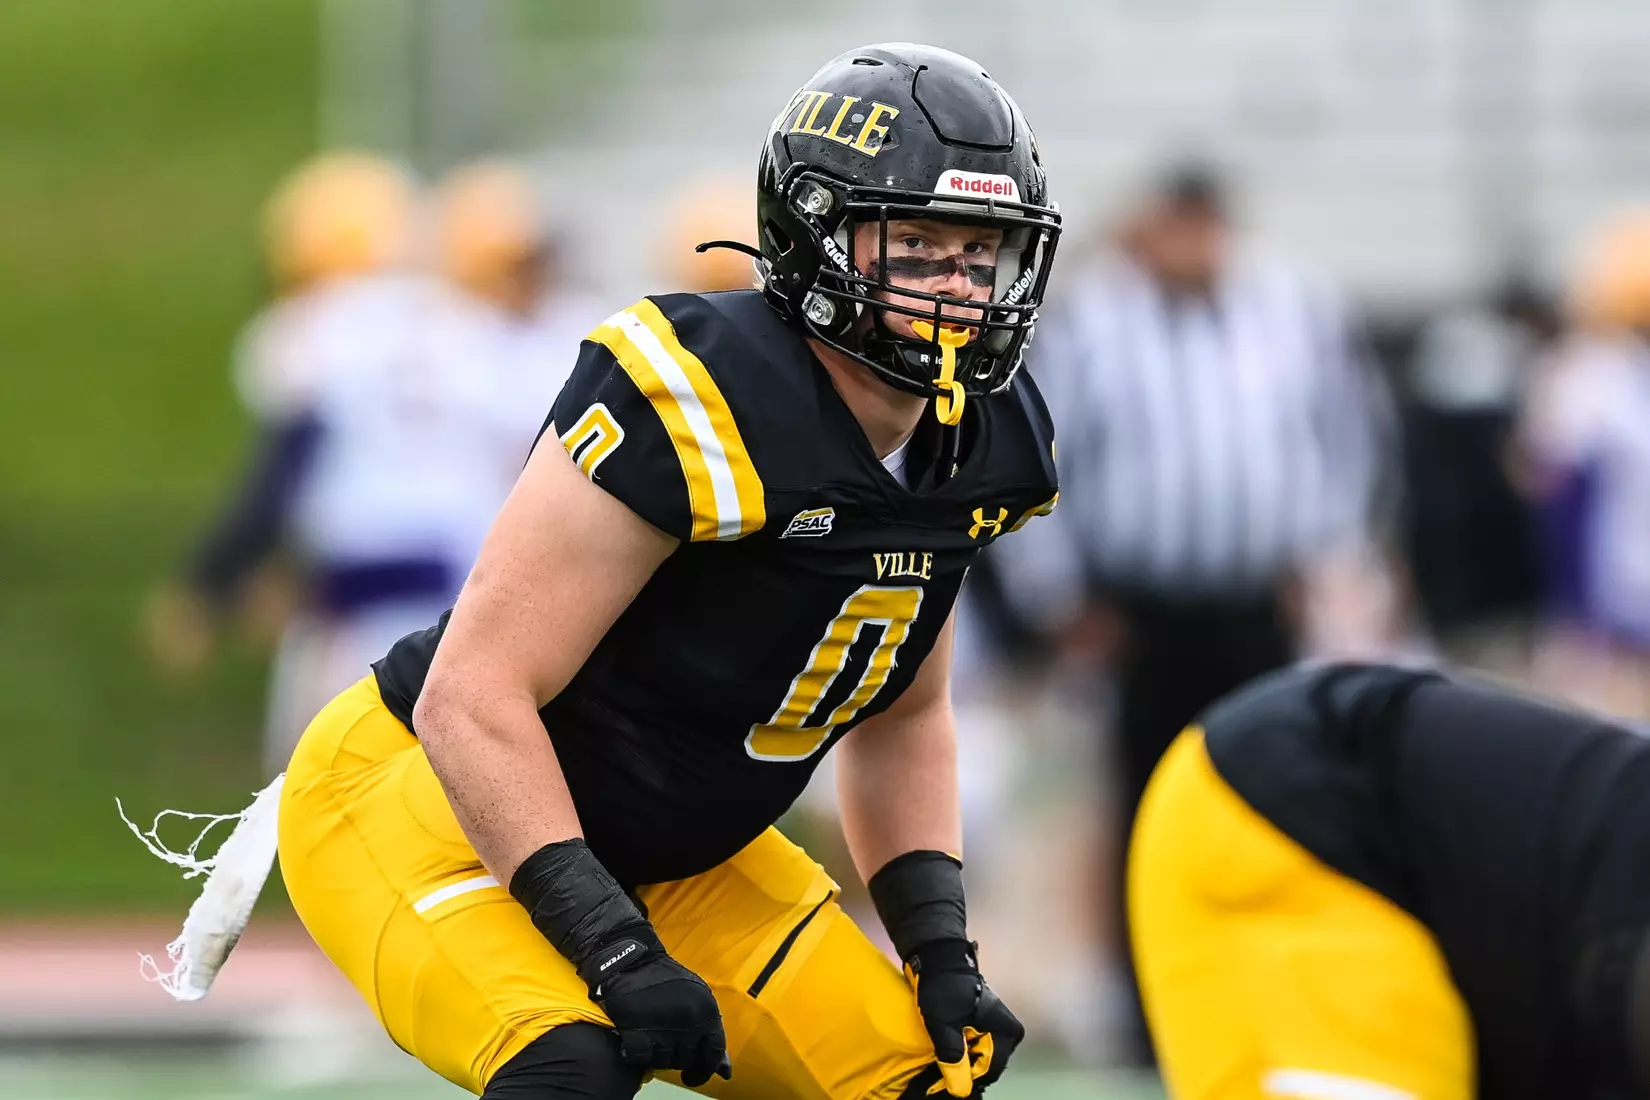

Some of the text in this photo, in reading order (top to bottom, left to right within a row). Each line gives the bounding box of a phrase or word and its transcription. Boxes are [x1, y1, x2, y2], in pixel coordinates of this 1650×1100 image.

[951, 177, 1012, 195] Riddell
[791, 514, 831, 530] PSAC
[873, 552, 933, 580] VILLE
[744, 584, 923, 762] 0
[600, 943, 636, 971] CUTTERS
